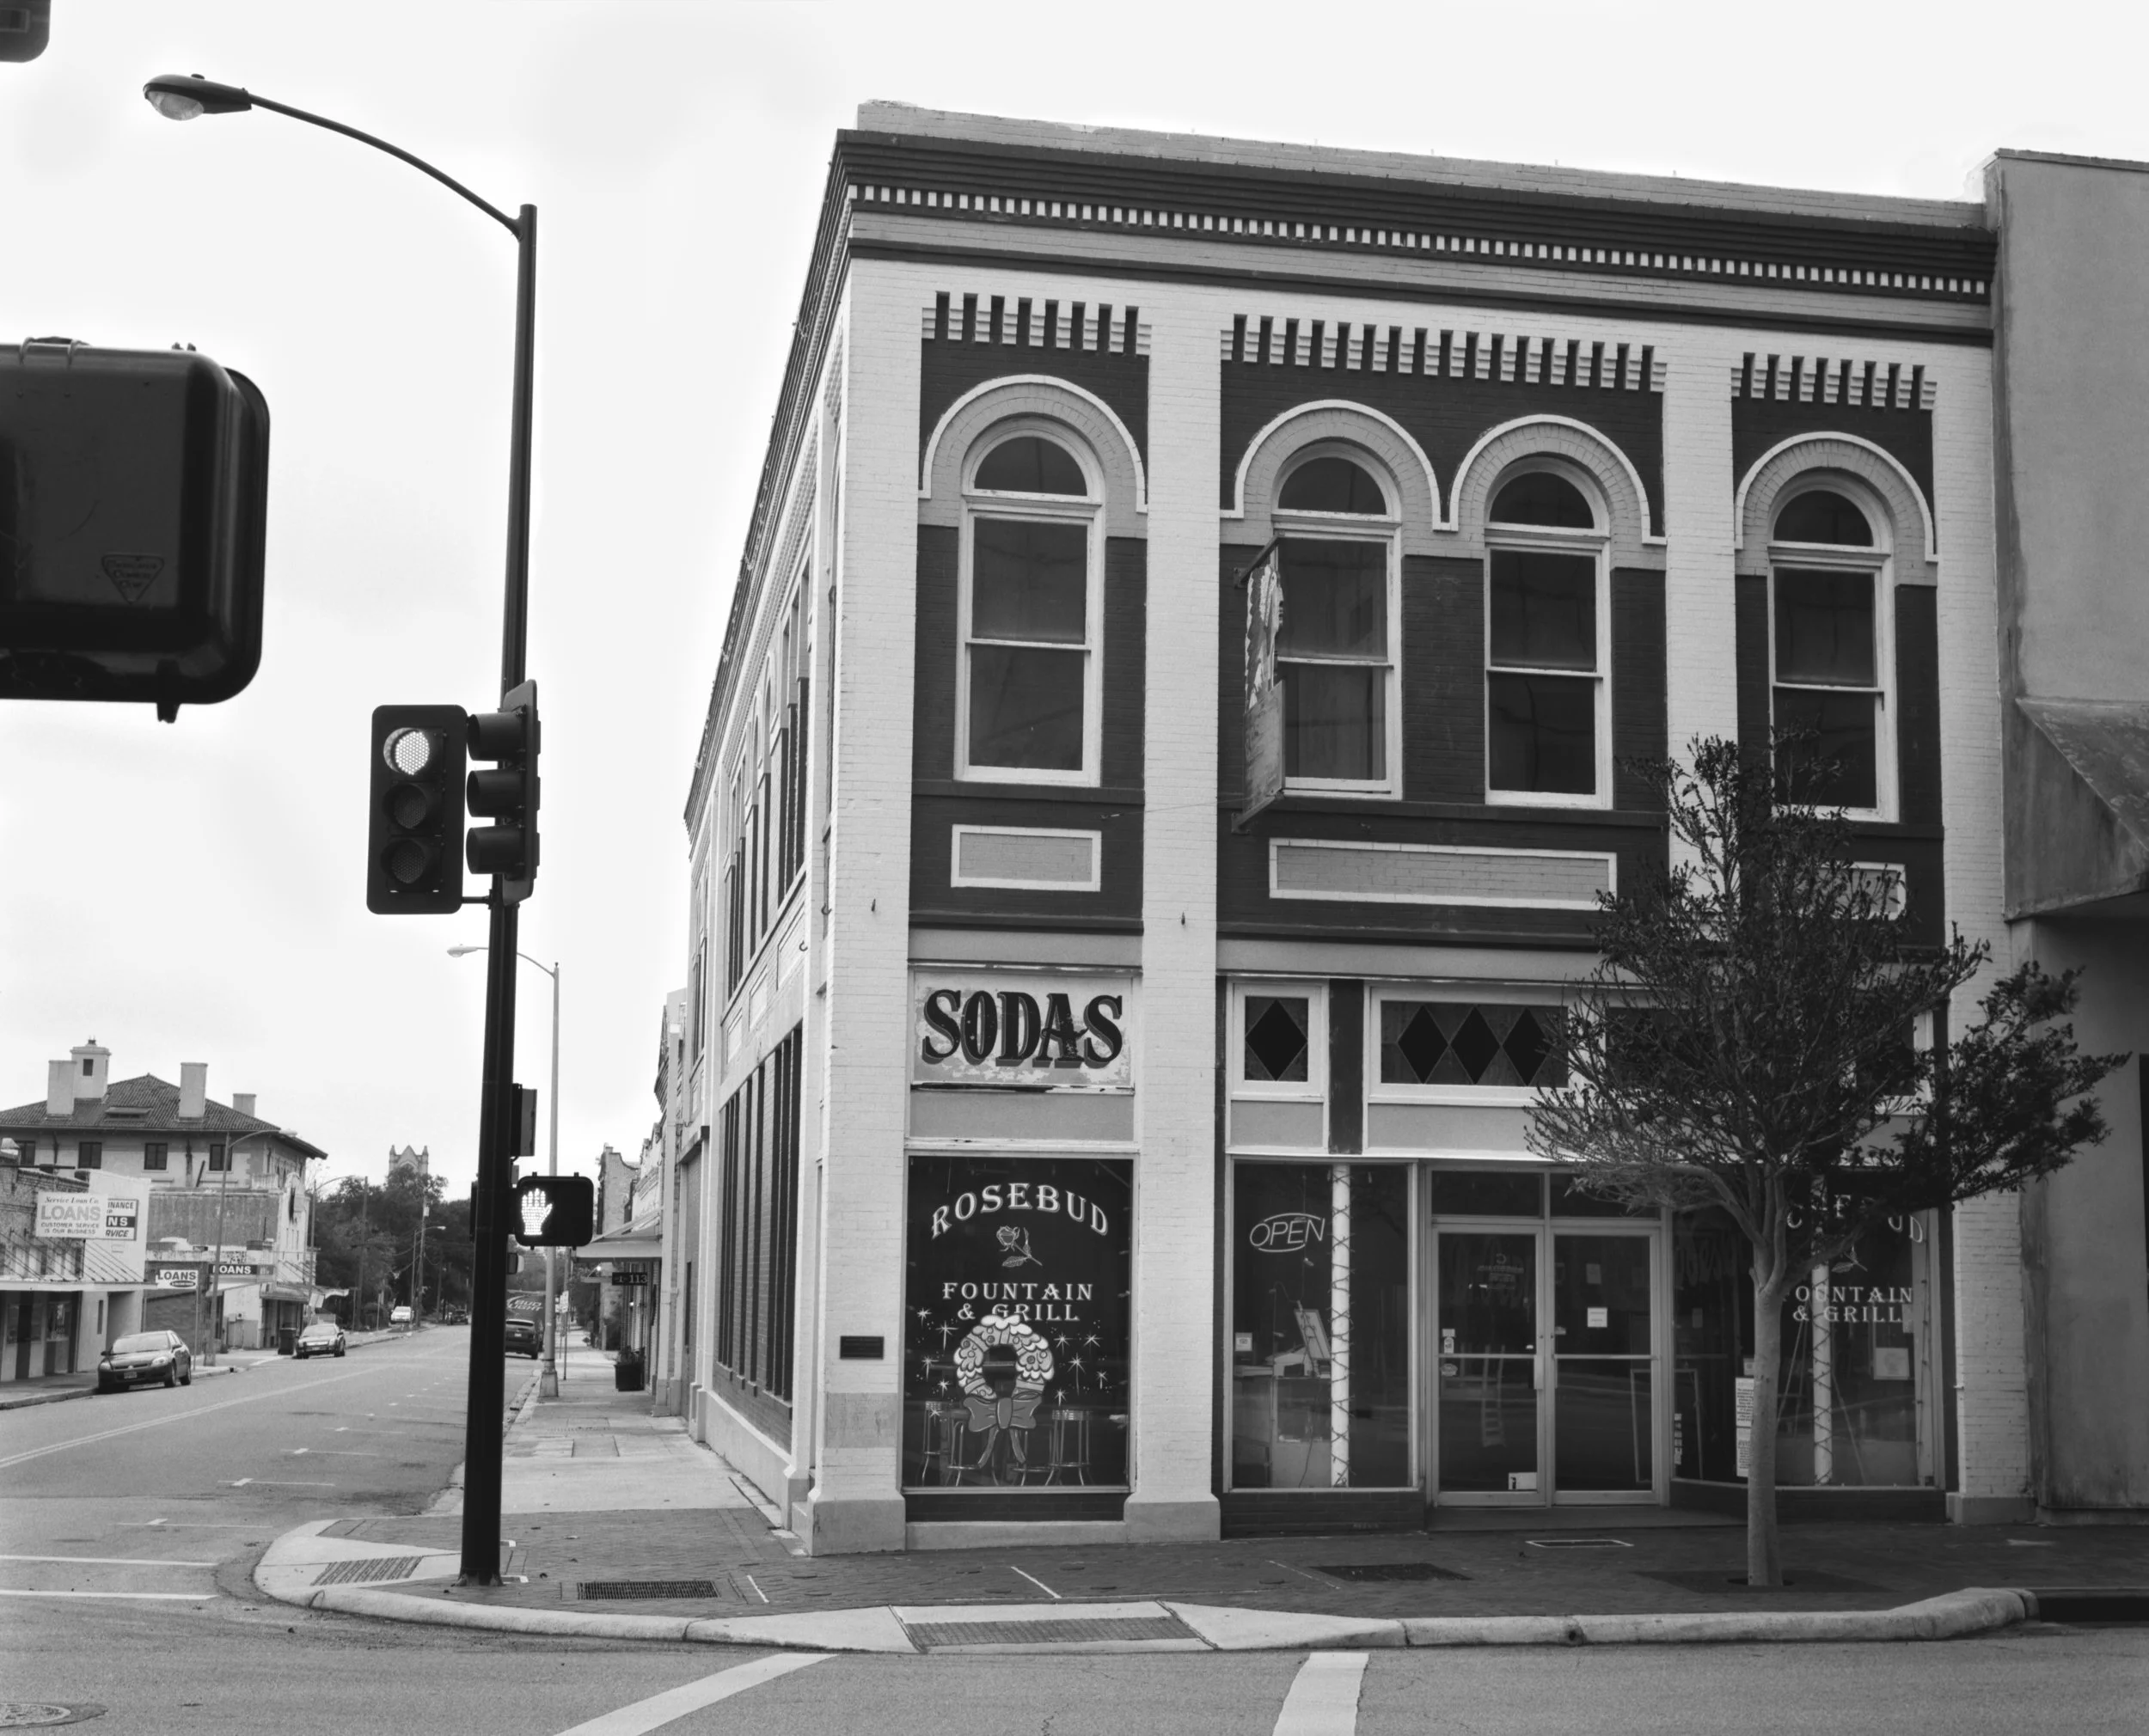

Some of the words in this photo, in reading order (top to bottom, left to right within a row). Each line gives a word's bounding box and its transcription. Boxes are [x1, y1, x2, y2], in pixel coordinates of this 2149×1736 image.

[922, 989, 1123, 1069] SODAS
[41, 1205, 101, 1220] LOANS
[932, 1183, 1109, 1240] ROSEBUD
[105, 1229, 129, 1238] RVICE
[1250, 1218, 1326, 1247] OPEN
[157, 1271, 197, 1281] LOANS
[942, 1282, 1093, 1301] FOUNTAIN
[1782, 1286, 1913, 1303] OUNTAIN
[507, 1303, 544, 1311] LIGHT
[957, 1303, 976, 1320] &
[991, 1304, 1080, 1322] GRILL
[1792, 1305, 1810, 1322] &
[1823, 1305, 1904, 1323] GRILL
